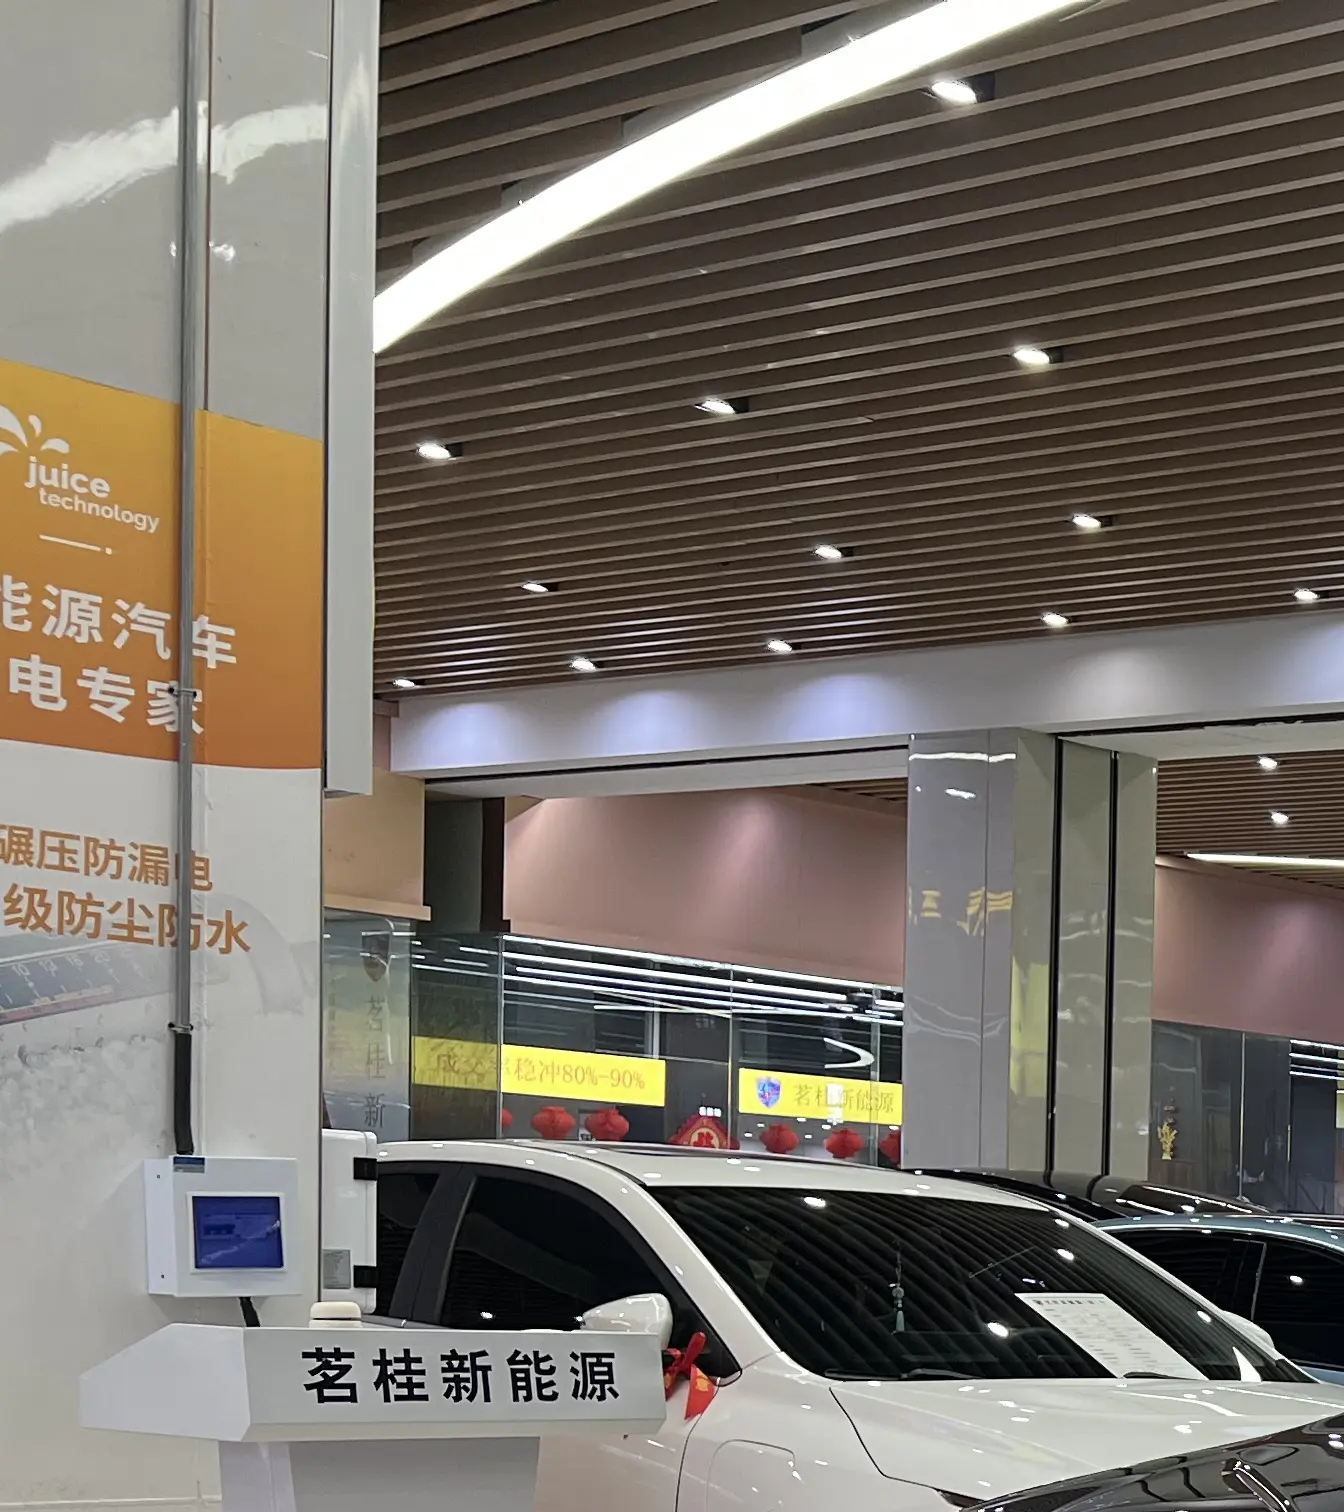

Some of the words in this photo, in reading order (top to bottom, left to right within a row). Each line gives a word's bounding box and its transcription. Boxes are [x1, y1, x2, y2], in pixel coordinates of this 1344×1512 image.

[24, 456, 111, 499] juice
[39, 487, 160, 533] technology
[8, 653, 205, 736] 电专家
[3, 883, 251, 955] 级防尘防水
[301, 1346, 620, 1404] 茗桂新能源
